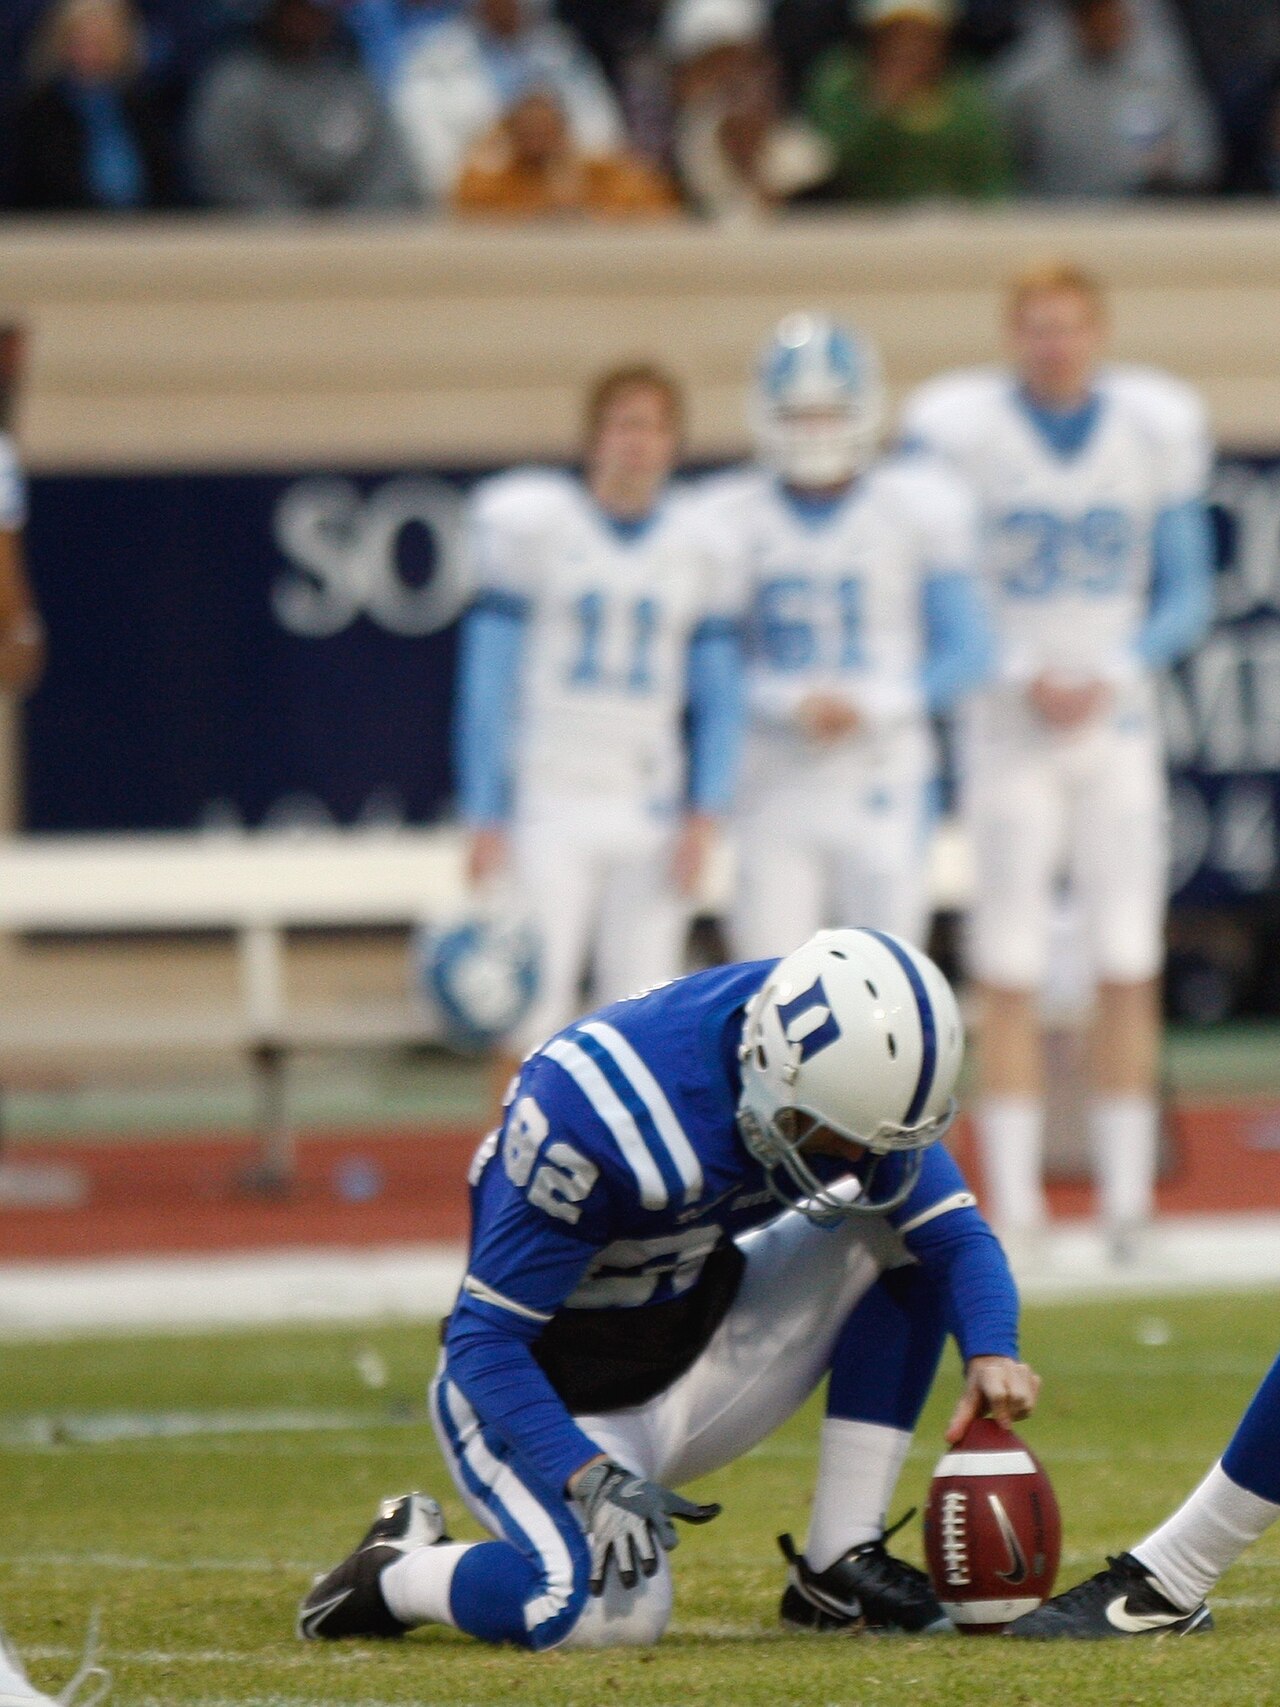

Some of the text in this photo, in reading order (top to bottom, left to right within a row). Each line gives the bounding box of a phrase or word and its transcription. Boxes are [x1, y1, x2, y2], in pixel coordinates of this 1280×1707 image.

[1000, 507, 1132, 597] 39
[565, 589, 660, 693] 11
[753, 576, 867, 673] 61
[503, 1096, 600, 1226] 82
